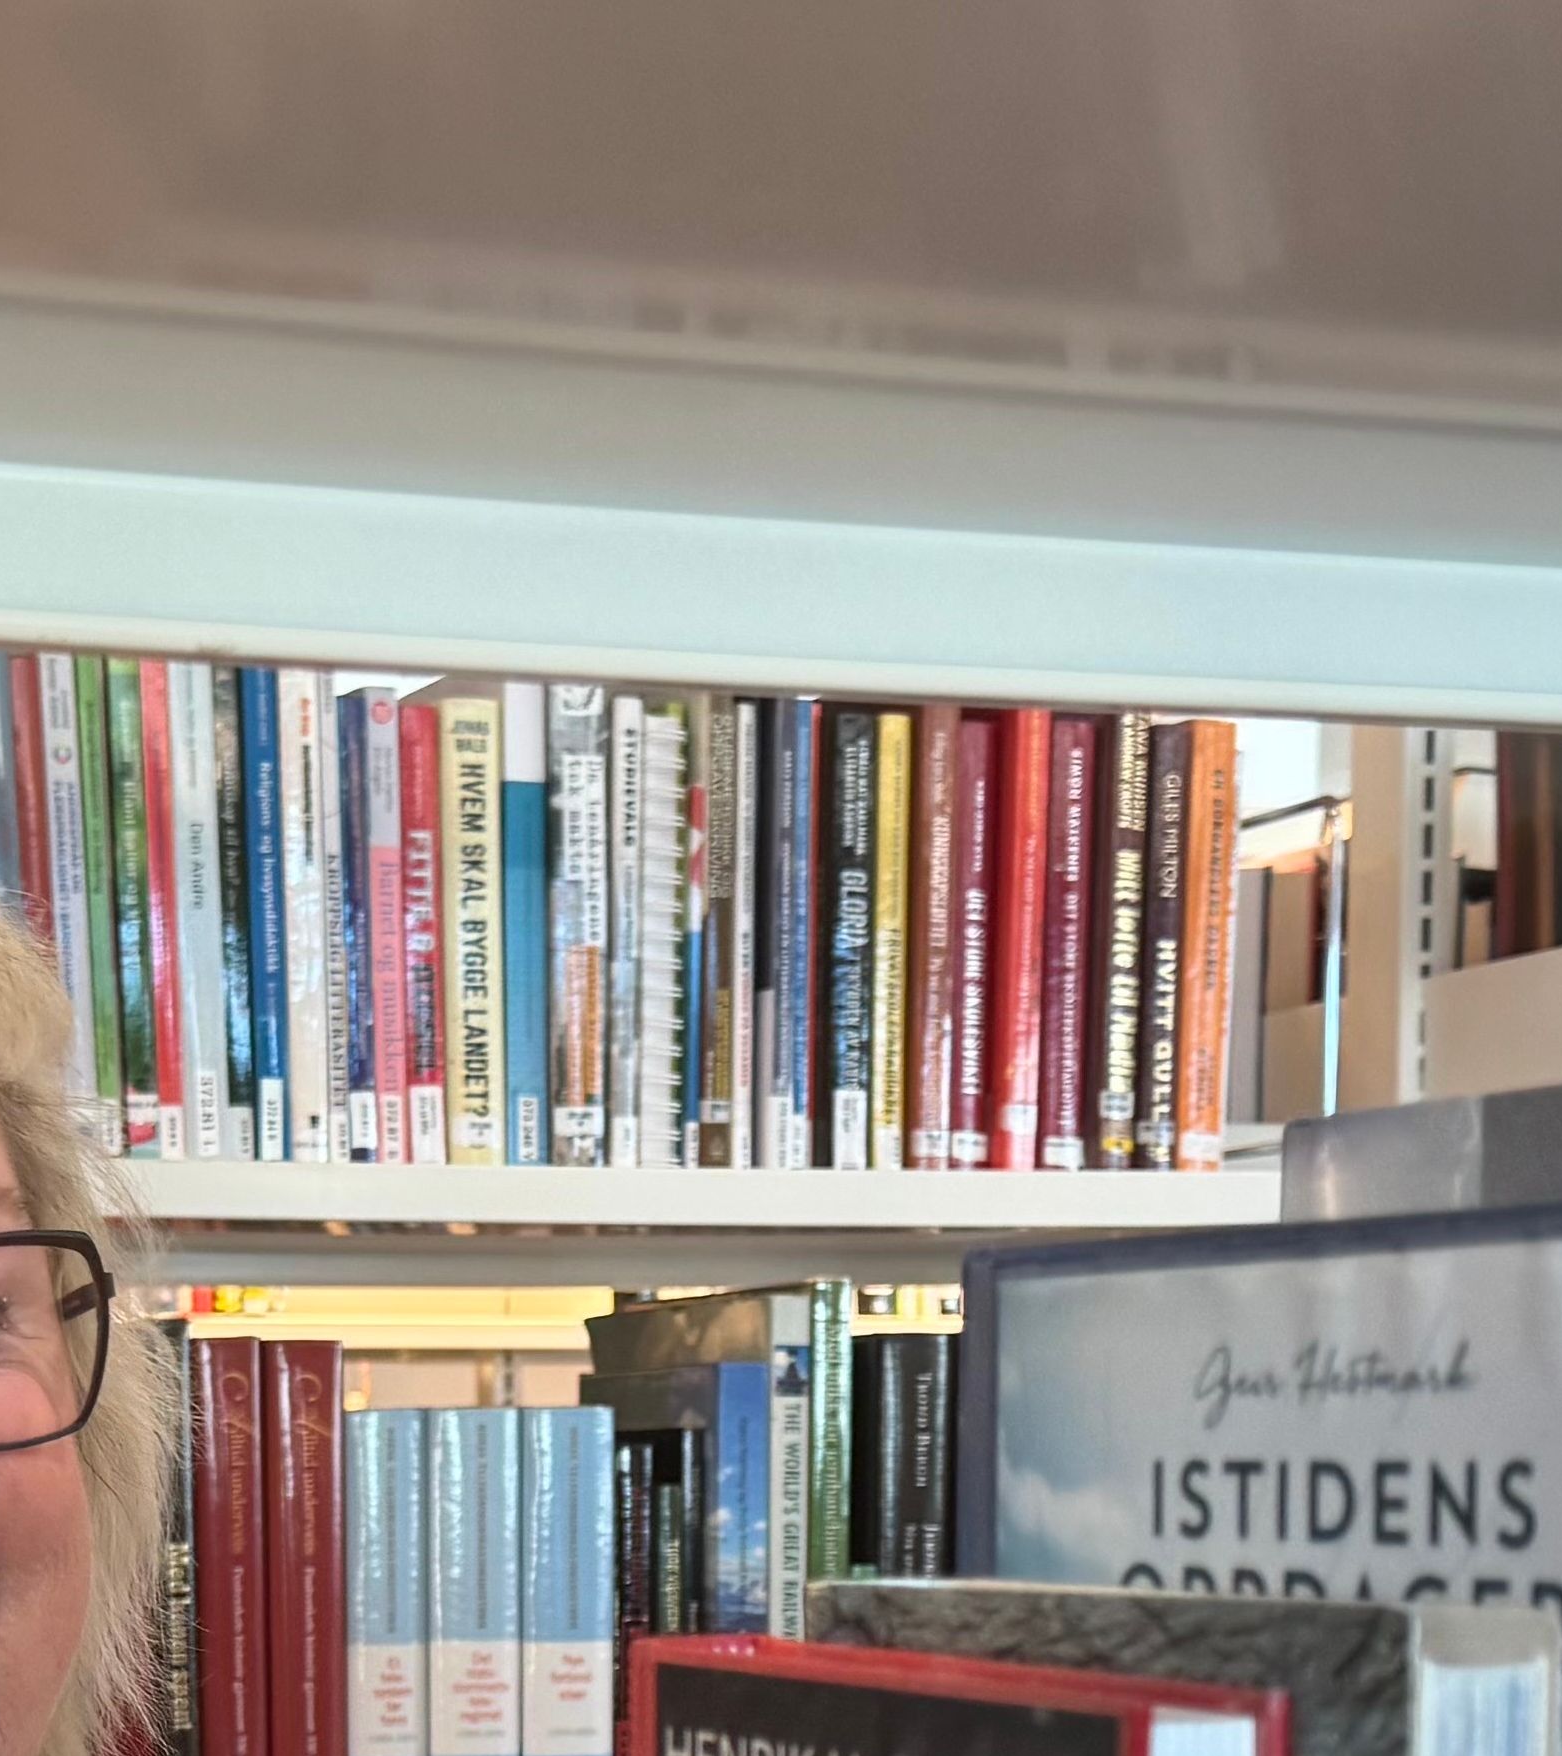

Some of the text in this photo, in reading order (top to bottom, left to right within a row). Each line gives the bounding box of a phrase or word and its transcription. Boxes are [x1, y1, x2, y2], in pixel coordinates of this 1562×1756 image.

[190, 822, 206, 910] Den Andre
[1159, 772, 1182, 900] GILES MILTON
[327, 853, 345, 964] KROPPSLIG
[459, 762, 490, 1118] HVEM SKAL BYGGE LANDET?
[840, 868, 870, 948] GLORIA
[376, 944, 396, 974] og
[383, 980, 404, 1092] musikken
[1153, 938, 1179, 1122] HVITT GULL
[784, 1403, 802, 1435] THE
[783, 1443, 802, 1516] WORLD'S
[1149, 1455, 1540, 1551] ISTIDENS
[783, 1522, 801, 1574] GREAT
